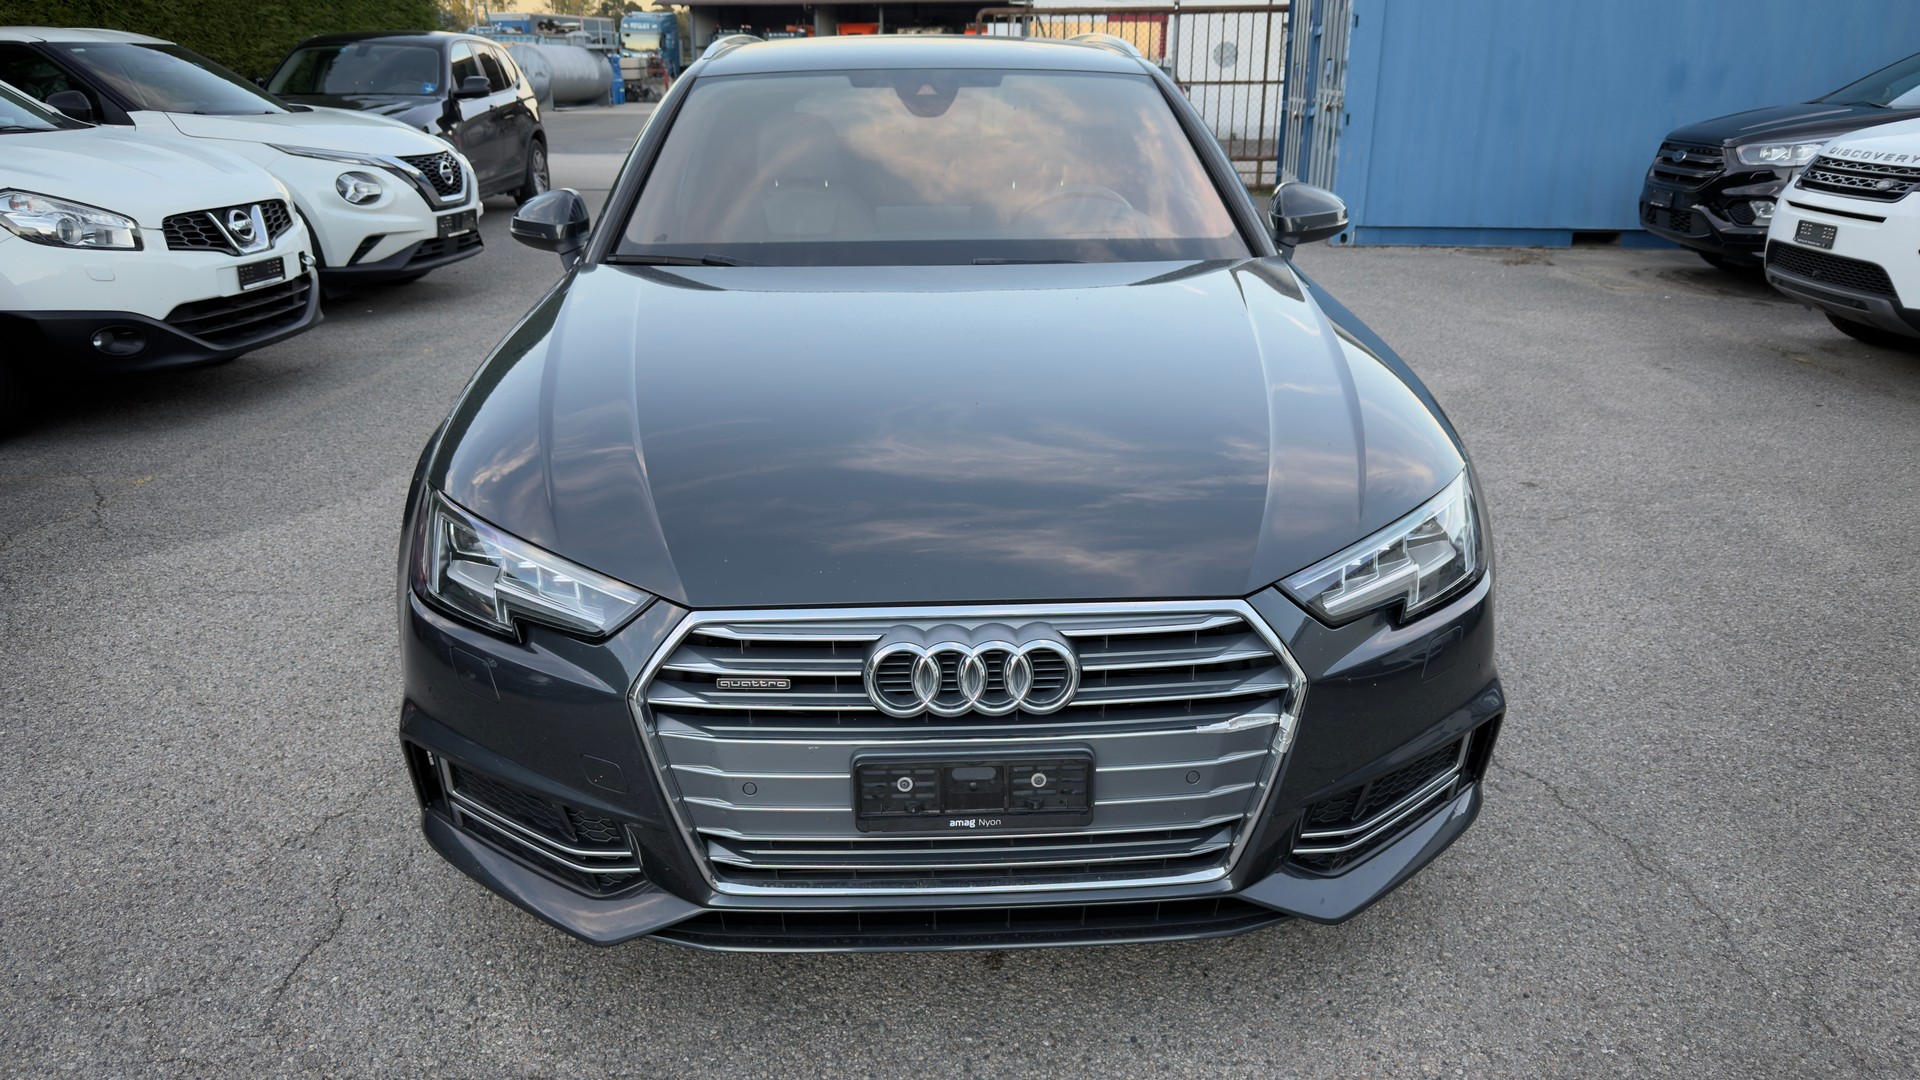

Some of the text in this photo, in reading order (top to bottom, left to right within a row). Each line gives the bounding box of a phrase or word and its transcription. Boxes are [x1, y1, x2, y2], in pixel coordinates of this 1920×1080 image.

[1828, 146, 1920, 163] DISCOVERY
[720, 680, 787, 688] quattro
[949, 818, 1002, 828] amag Nyon
